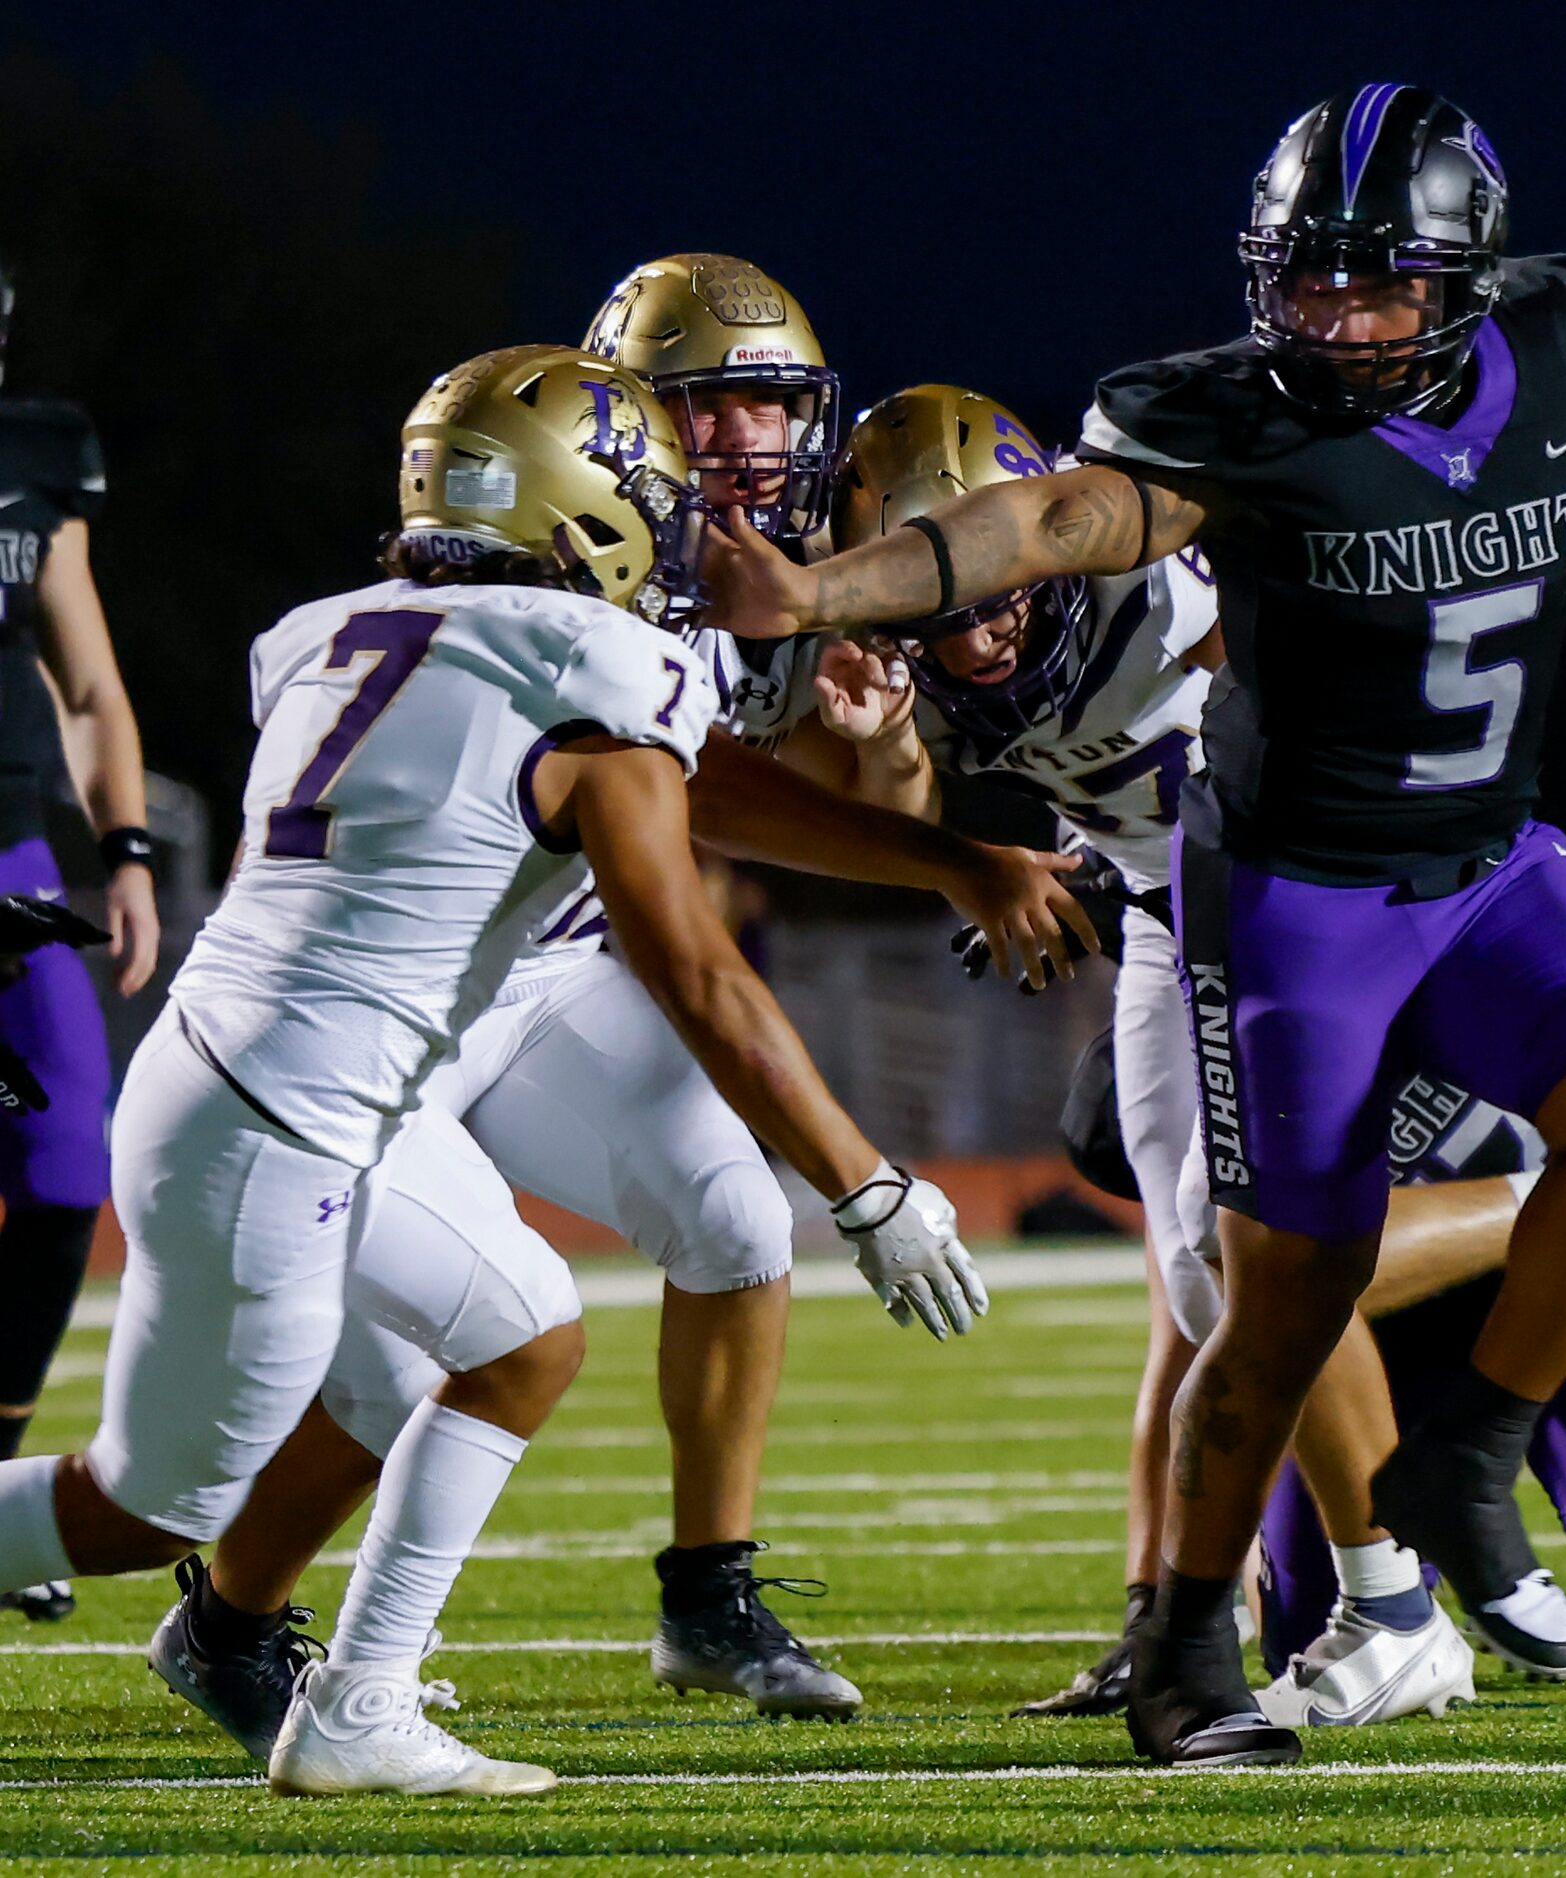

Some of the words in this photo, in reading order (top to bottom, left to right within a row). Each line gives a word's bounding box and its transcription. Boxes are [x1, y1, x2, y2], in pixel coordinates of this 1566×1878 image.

[736, 349, 794, 361] Riddell
[264, 606, 452, 859] 7
[649, 652, 691, 735] 7
[1401, 577, 1545, 791] 5
[1190, 962, 1250, 1186] KNIGHTS
